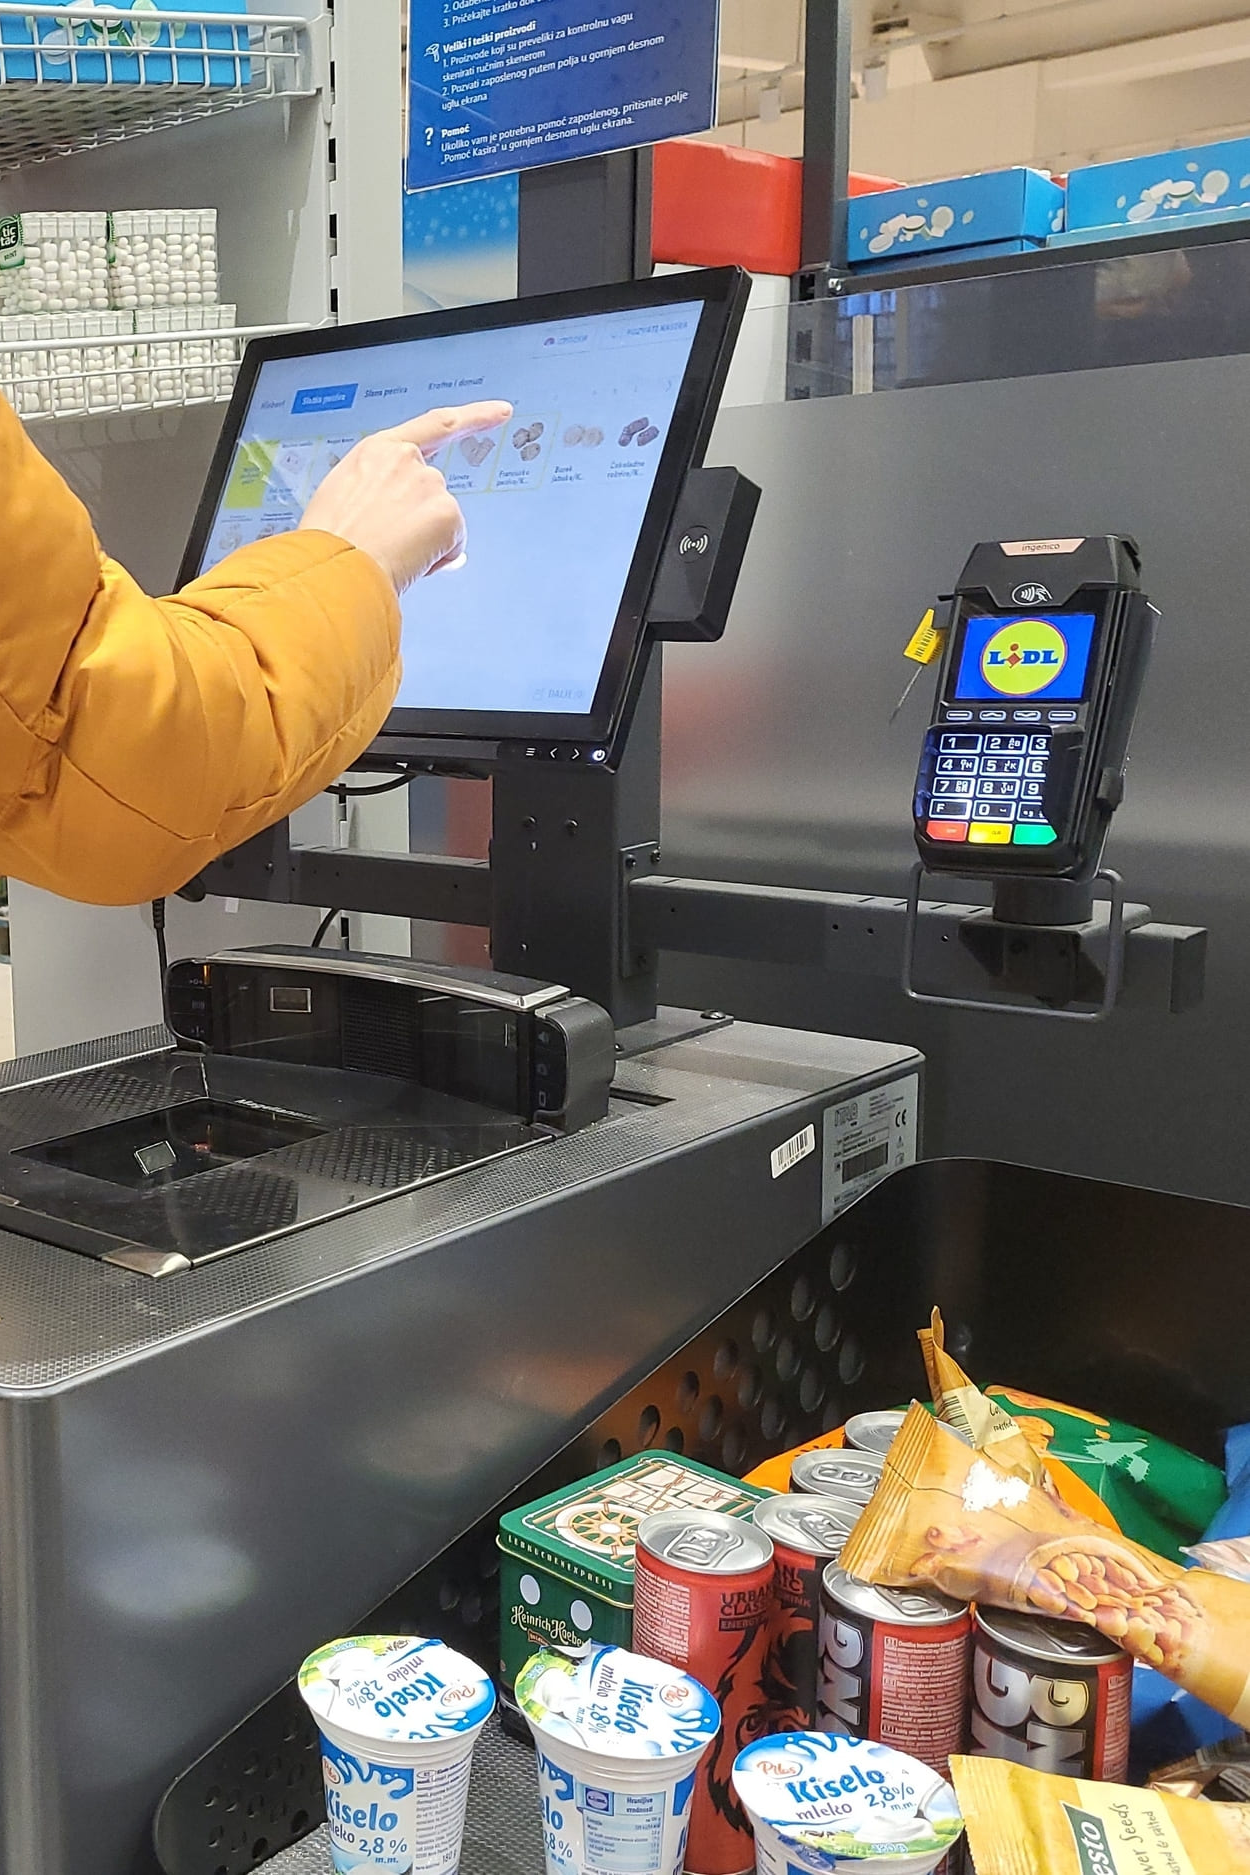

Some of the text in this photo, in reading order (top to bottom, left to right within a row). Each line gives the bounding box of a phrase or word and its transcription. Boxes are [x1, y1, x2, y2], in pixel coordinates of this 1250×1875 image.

[452, 8, 491, 26] Pričekajte
[492, 0, 518, 14] kratko
[443, 39, 467, 54] Veliki
[473, 32, 494, 46] teški
[495, 20, 537, 42] proizvodi
[450, 48, 490, 66] Proizvode
[491, 44, 505, 56] koji
[507, 43, 517, 52] su
[518, 32, 554, 50] preveliki
[555, 30, 566, 39] za
[567, 18, 610, 36] kontrolnu
[611, 12, 634, 25] vagu
[442, 49, 546, 82] skenirati ručnim skenerom
[451, 79, 480, 94] Pozvati
[481, 67, 528, 87] zaposlenog
[528, 61, 556, 77] putem
[557, 56, 580, 70] polja
[581, 54, 588, 63] u
[589, 44, 626, 63] gornjem
[627, 35, 665, 51] desnom
[442, 92, 488, 111] uglu ekrana
[441, 138, 470, 153] Ukoliko
[471, 134, 488, 146] vam
[489, 132, 498, 144] je
[498, 124, 536, 141] potrebna
[537, 116, 567, 134] pomoć
[622, 97, 663, 115] pritisnite
[664, 91, 689, 107] polje
[441, 123, 470, 138] Pomoć
[501, 142, 508, 151] u
[509, 136, 543, 152] gornjem
[544, 128, 578, 142] desnom
[580, 122, 600, 136] uglu
[0, 234, 16, 247] tac
[2, 225, 16, 238] tic
[1021, 542, 1061, 552] ingenico
[948, 737, 957, 749] 1
[990, 738, 1001, 749] 2
[1035, 738, 1047, 750] 3
[942, 759, 953, 771] 4
[986, 760, 997, 772] 5
[1031, 760, 1043, 772] 6
[939, 780, 950, 792] 7
[982, 782, 994, 794] 8
[1027, 783, 1040, 795] 9
[936, 803, 945, 813] F
[510, 1604, 552, 1632] Heinrich
[387, 1655, 425, 1682] mleko
[596, 1664, 618, 1698] mleko
[374, 1671, 446, 1718] Kiselo
[614, 1678, 654, 1735] Kiselo
[756, 1760, 797, 1776] Pilos
[785, 1765, 886, 1804] Kiselo
[325, 1784, 398, 1832] Kiselo
[796, 1782, 915, 1821] mleko 2,8%
[1108, 1802, 1144, 1844] Seeds
